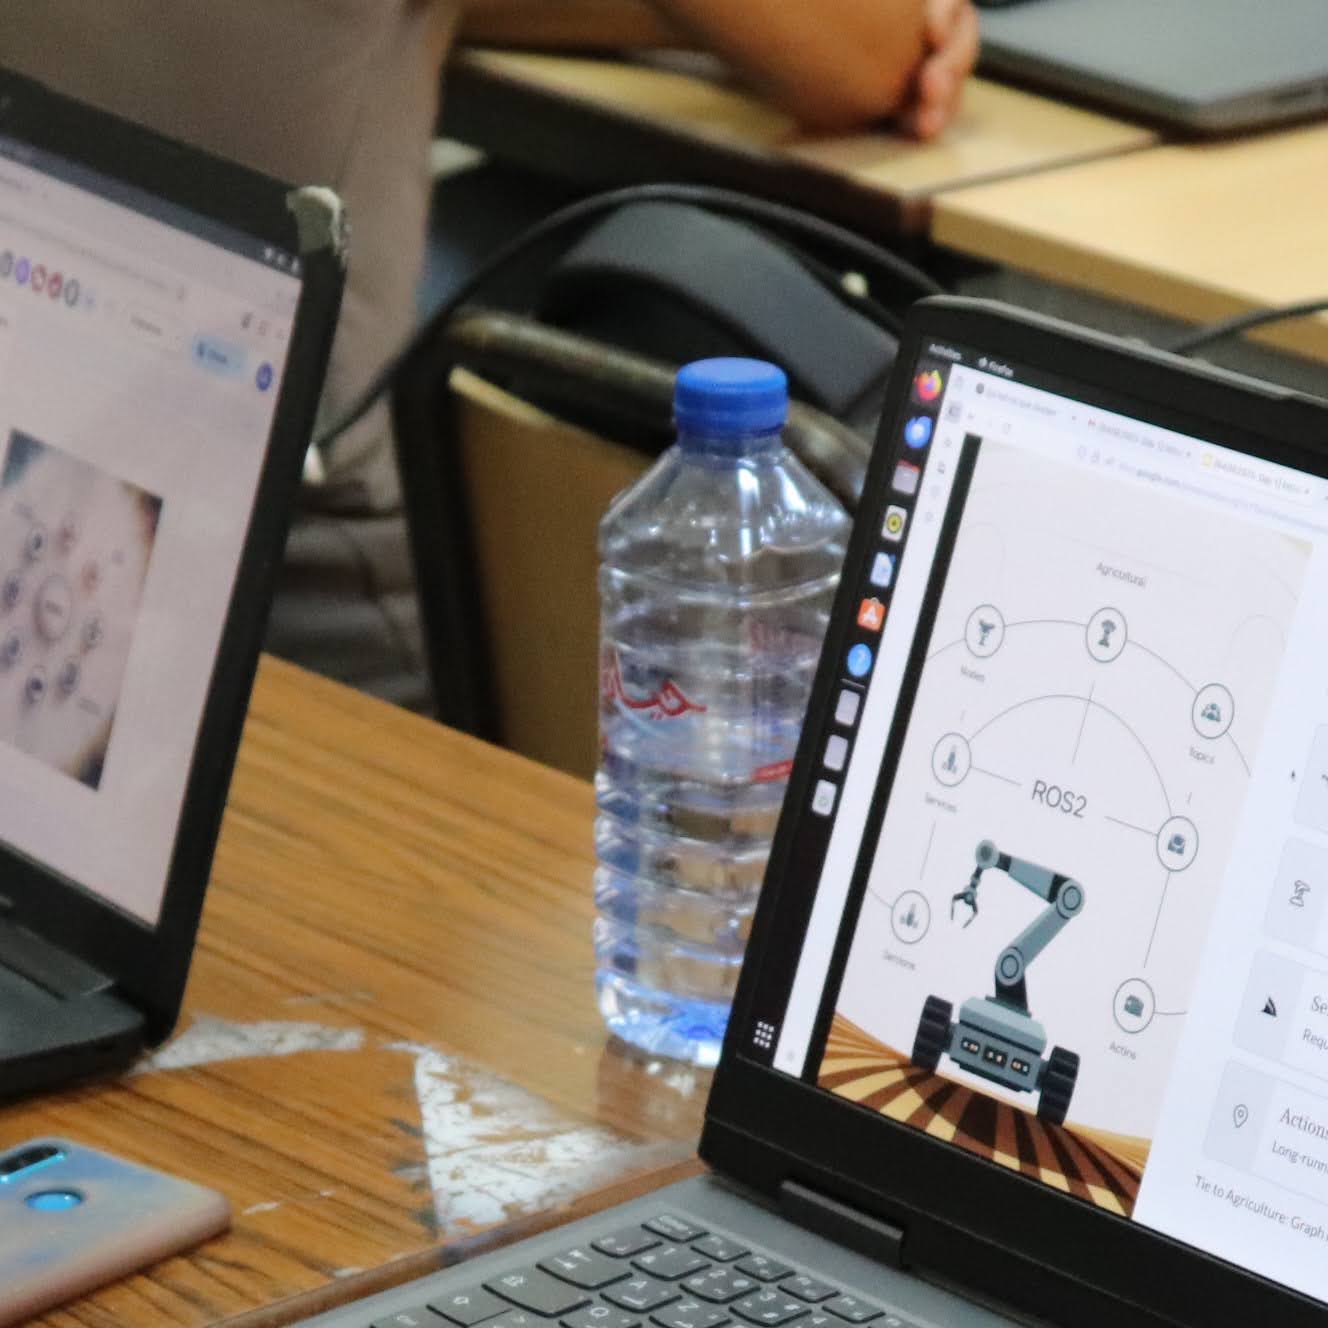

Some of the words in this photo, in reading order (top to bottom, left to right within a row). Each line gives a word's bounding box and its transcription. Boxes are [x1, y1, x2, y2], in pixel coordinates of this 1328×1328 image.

[1030, 778, 1088, 819] ROS2
[1212, 1183, 1225, 1198] to
[1225, 1188, 1290, 1226] Agriculture:
[1290, 1214, 1325, 1241] Graph
